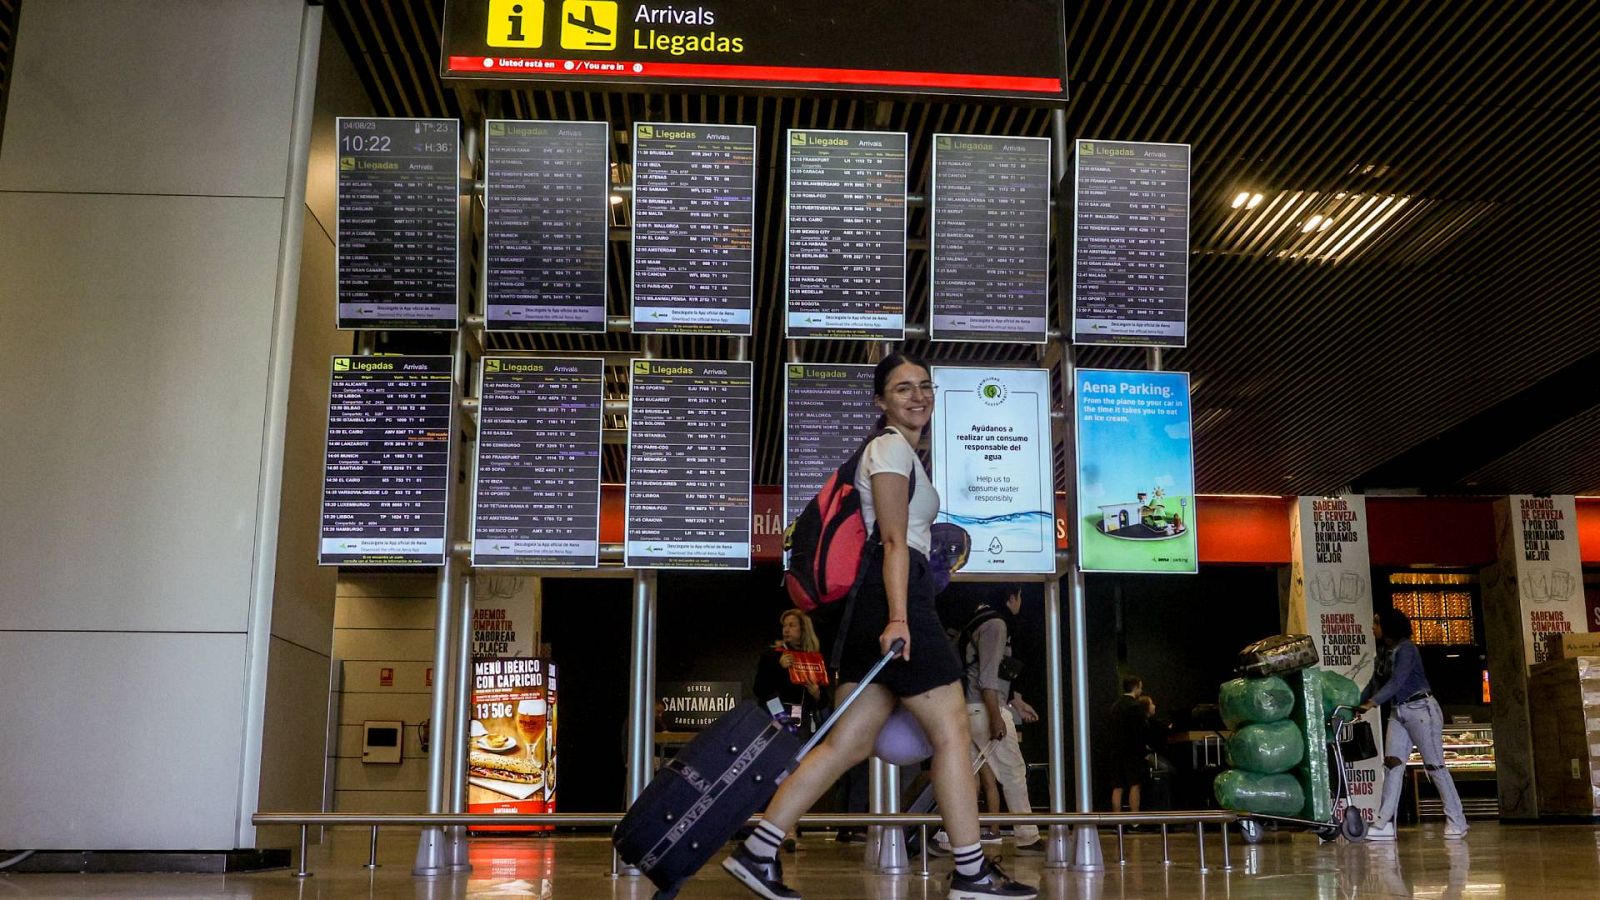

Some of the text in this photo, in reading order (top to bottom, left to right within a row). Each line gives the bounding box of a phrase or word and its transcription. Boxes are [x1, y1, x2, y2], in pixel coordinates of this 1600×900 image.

[634, 4, 715, 25] Arrivals
[634, 29, 744, 56] Llegadas
[499, 58, 523, 67] Usted
[524, 59, 543, 68] está
[584, 62, 600, 70] You
[616, 63, 625, 71] in
[344, 122, 376, 130] 04/08/23
[656, 130, 696, 140] Llegadas
[342, 135, 391, 152] 10:22
[809, 137, 849, 146] Llegadas
[425, 143, 448, 152] H:36
[1096, 147, 1135, 157] Llegadas
[352, 362, 394, 372] Llegadas
[502, 363, 544, 372] Llegadas
[652, 366, 693, 375] Llegadas
[806, 369, 847, 379] Llegadas
[1083, 381, 1174, 398] Aena Parking.
[1084, 397, 1102, 405] From
[1103, 397, 1115, 405] the
[1116, 398, 1136, 407] plane
[1146, 400, 1163, 408] your
[1084, 405, 1096, 413] the
[1122, 407, 1142, 415] takes
[1143, 408, 1156, 416] you
[1106, 415, 1129, 423] cream.
[971, 424, 1007, 433] Ayúdanos
[956, 434, 984, 442] realizar
[964, 443, 1009, 452] responsable
[976, 475, 993, 483] Help
[975, 494, 1013, 503] responsibly
[1312, 500, 1347, 511] SABEMOS
[1520, 499, 1554, 510] SABEMOS
[1313, 511, 1357, 522] DE CERVEZA
[1521, 509, 1564, 520] DE CERVEZA
[1314, 521, 1350, 532] Y POR ESO
[1522, 520, 1558, 530] Y POR ESO
[1315, 531, 1358, 542] BRINDAMOS
[1523, 530, 1565, 541] BRINDAMOS
[1315, 542, 1342, 553] CON LA
[1524, 540, 1550, 551] CON LA
[1316, 552, 1342, 563] MEJOR
[1525, 551, 1550, 561] MEJOR
[1320, 614, 1355, 624] SABEMOS
[1530, 611, 1564, 622] SABEMOS
[1321, 624, 1362, 635] COMPARTIR
[1531, 621, 1571, 632] COMPARTIR
[475, 631, 516, 642] SABOREAR
[1321, 635, 1366, 645] Y SABOREAR
[479, 642, 508, 653] PLACER
[1323, 645, 1360, 655] EL PLACER
[475, 659, 540, 675] MENÚ IBÉRICO
[476, 676, 495, 689] CON
[497, 673, 542, 688] CAPRICHO
[662, 693, 736, 712] SANTAMARÍA
[675, 717, 695, 725] SABER
